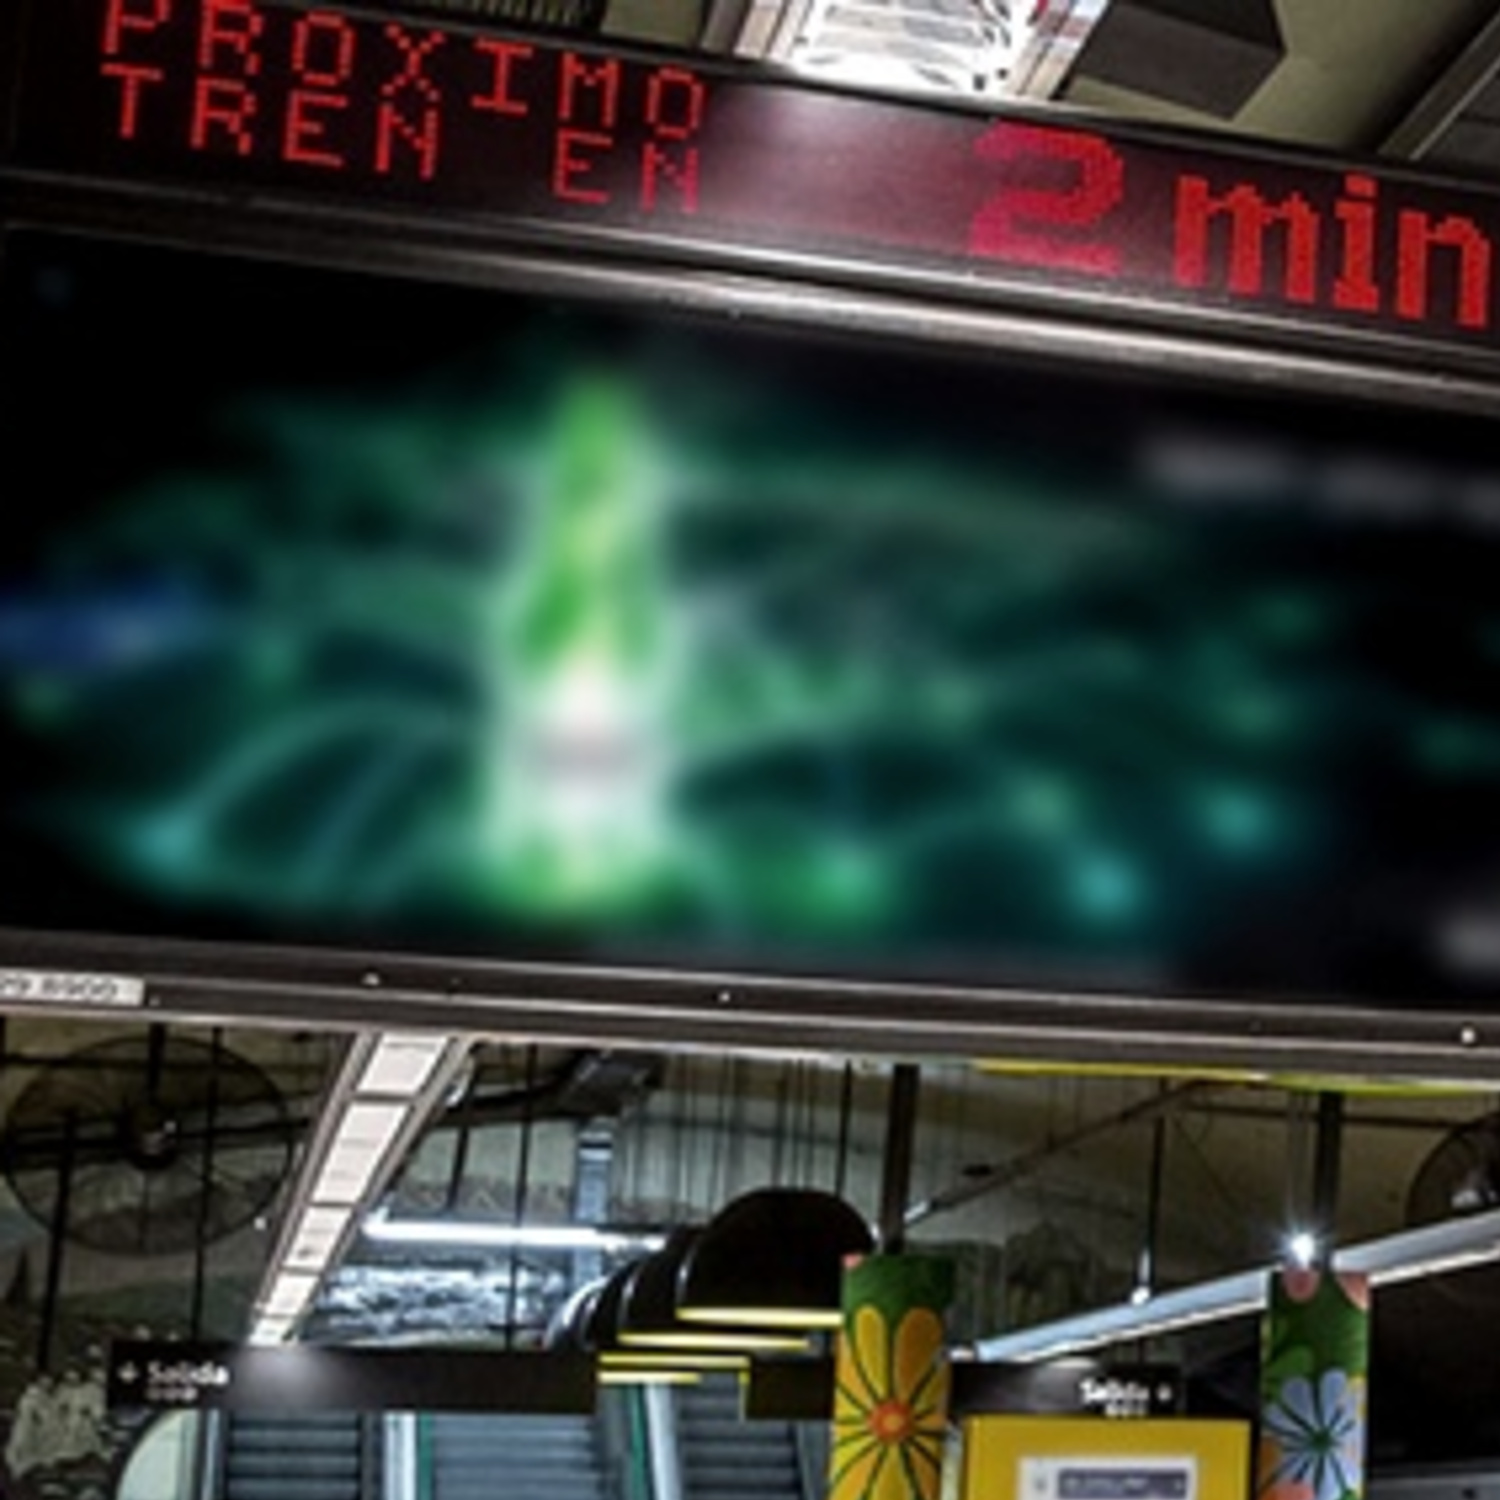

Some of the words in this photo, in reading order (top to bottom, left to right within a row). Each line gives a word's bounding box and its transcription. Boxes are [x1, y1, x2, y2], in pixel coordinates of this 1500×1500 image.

[102, 63, 438, 179] TREN
[552, 128, 698, 213] EN
[103, 0, 703, 138] PROXIMO
[967, 118, 1122, 276] 2
[1173, 172, 1490, 328] min
